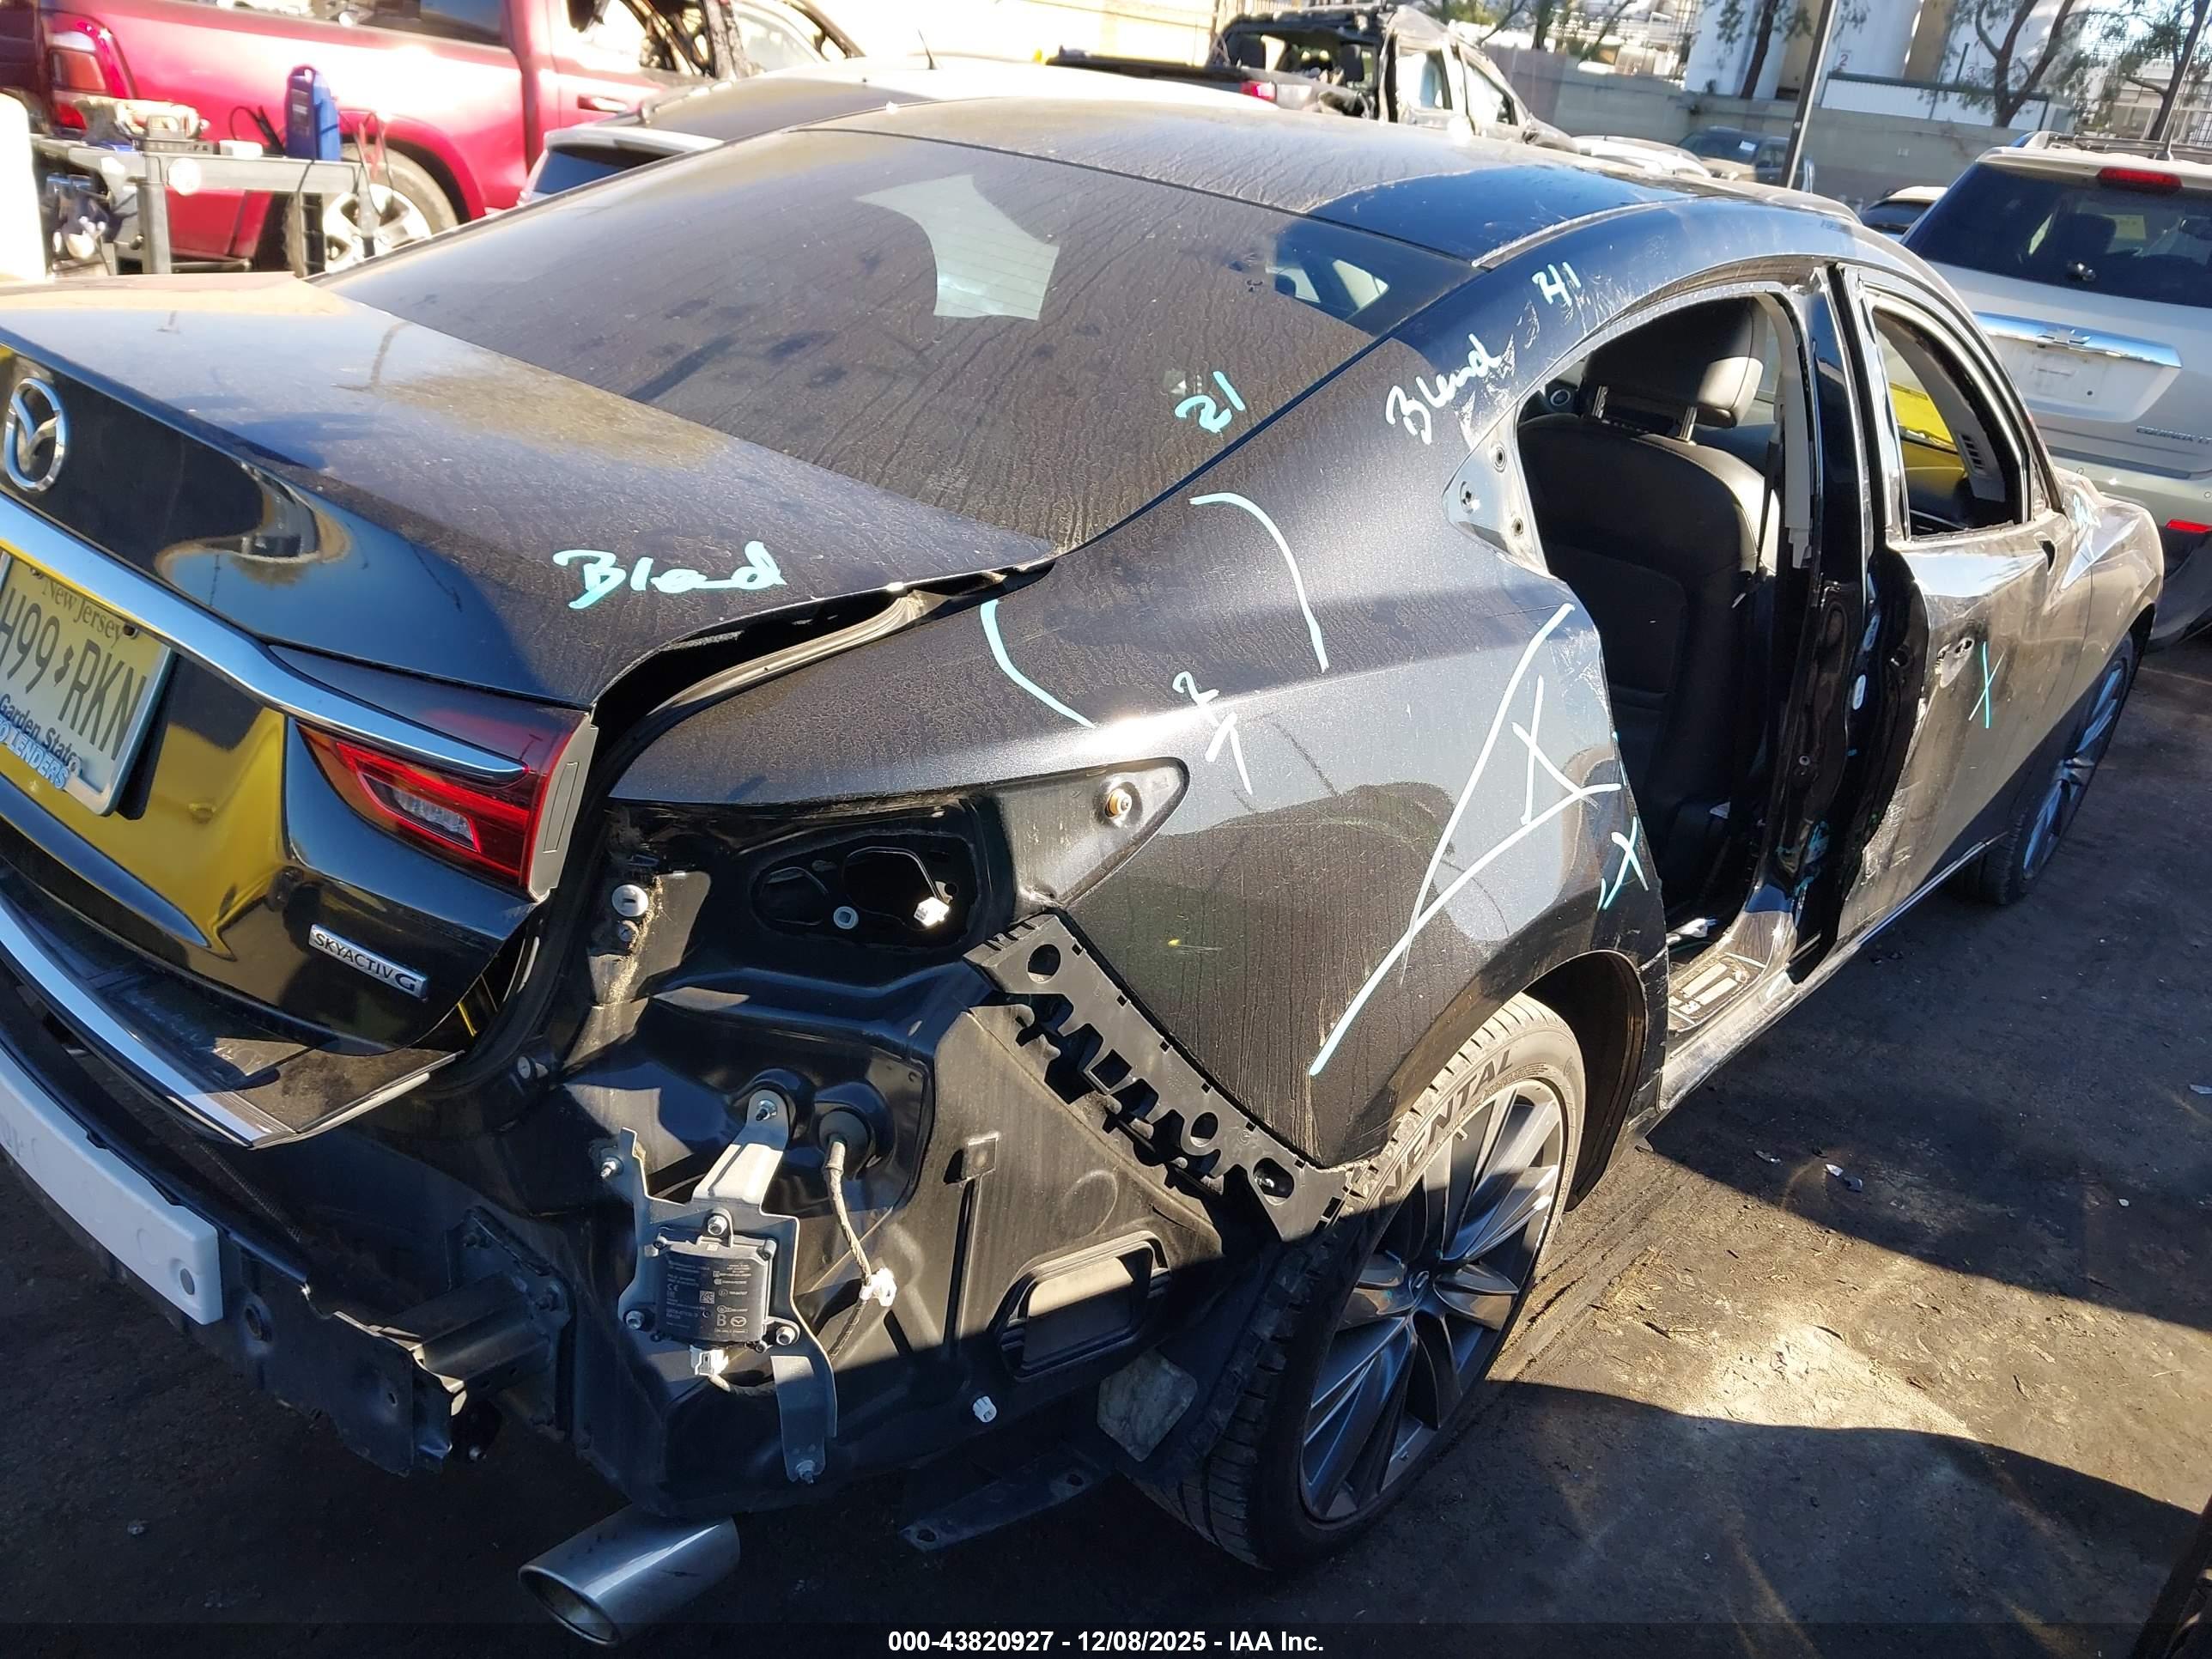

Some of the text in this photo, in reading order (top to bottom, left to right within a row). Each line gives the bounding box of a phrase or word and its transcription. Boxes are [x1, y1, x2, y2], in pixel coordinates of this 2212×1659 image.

[1385, 333, 1503, 445] Blend
[42, 578, 124, 648] New Jersey
[0, 693, 42, 740] Garden
[58, 638, 147, 762] RKN
[7, 728, 69, 789] LENDERS
[314, 933, 417, 992] SKYACTIV G
[716, 1314, 727, 1327] B
